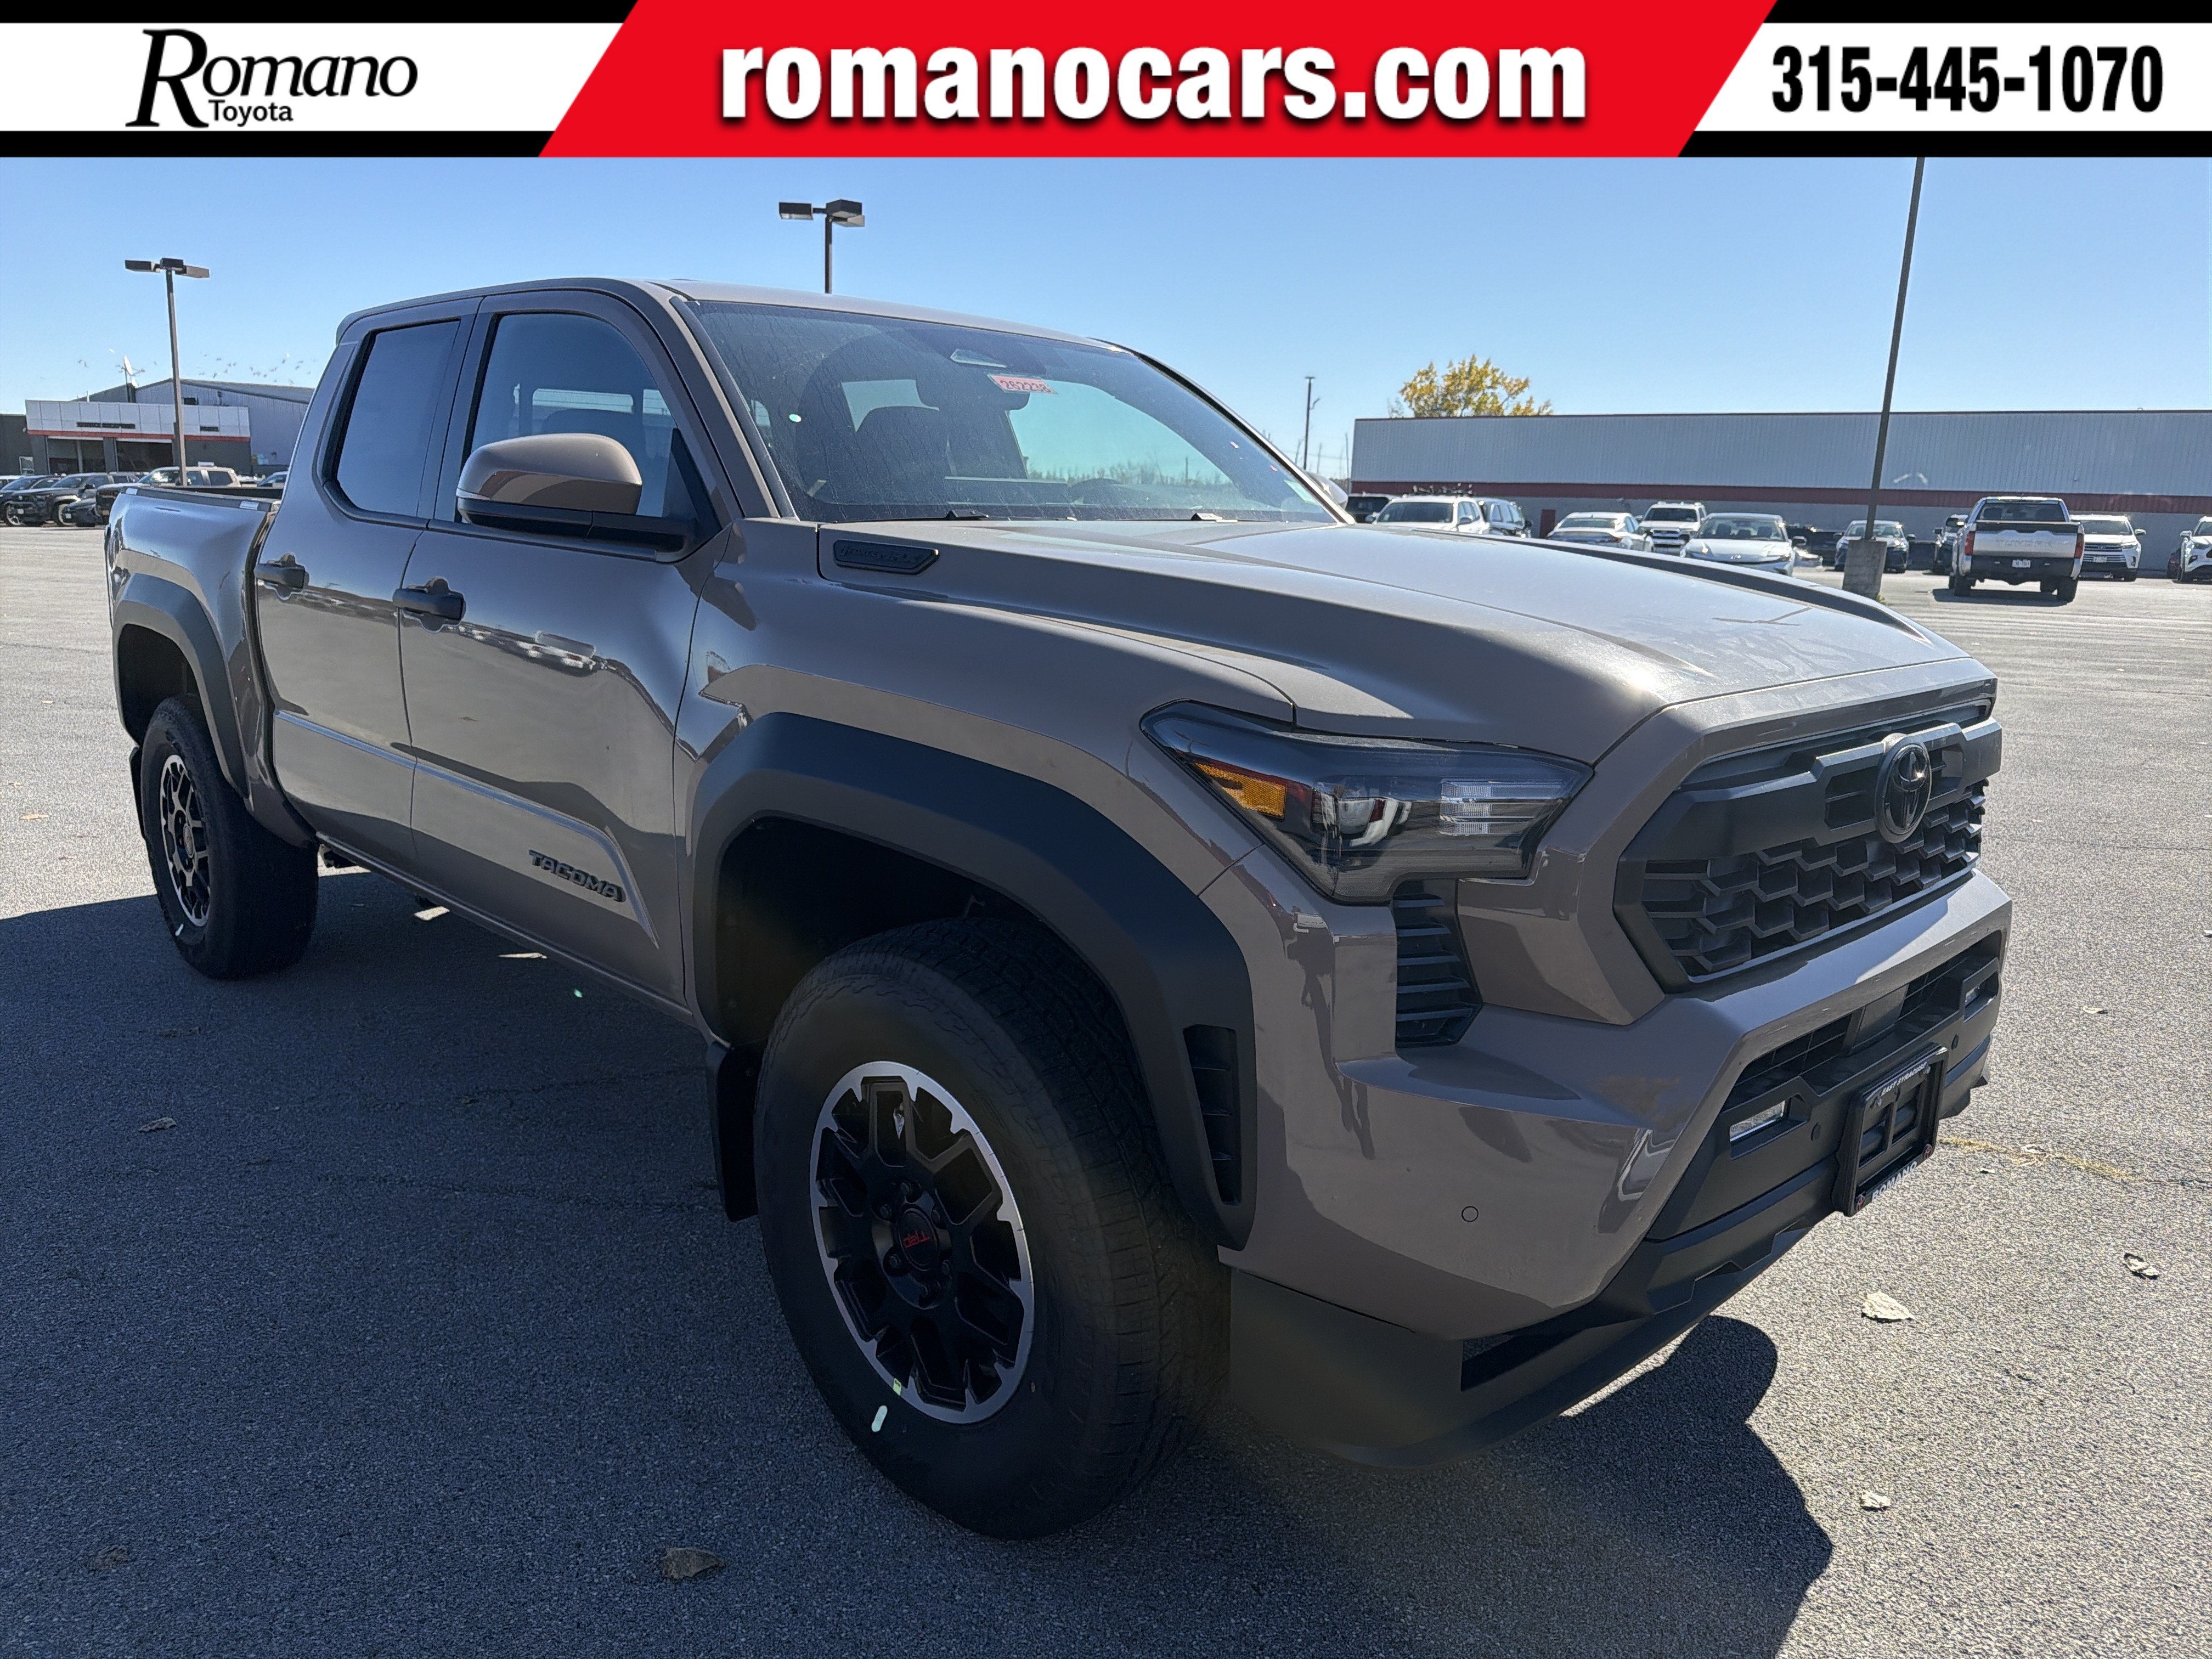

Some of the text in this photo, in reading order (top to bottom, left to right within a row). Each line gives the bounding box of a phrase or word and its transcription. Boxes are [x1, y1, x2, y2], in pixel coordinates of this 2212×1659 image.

[529, 849, 626, 902] TACOMA
[1881, 1080, 1898, 1097] EAST
[1871, 1161, 1917, 1203] ROMANO
